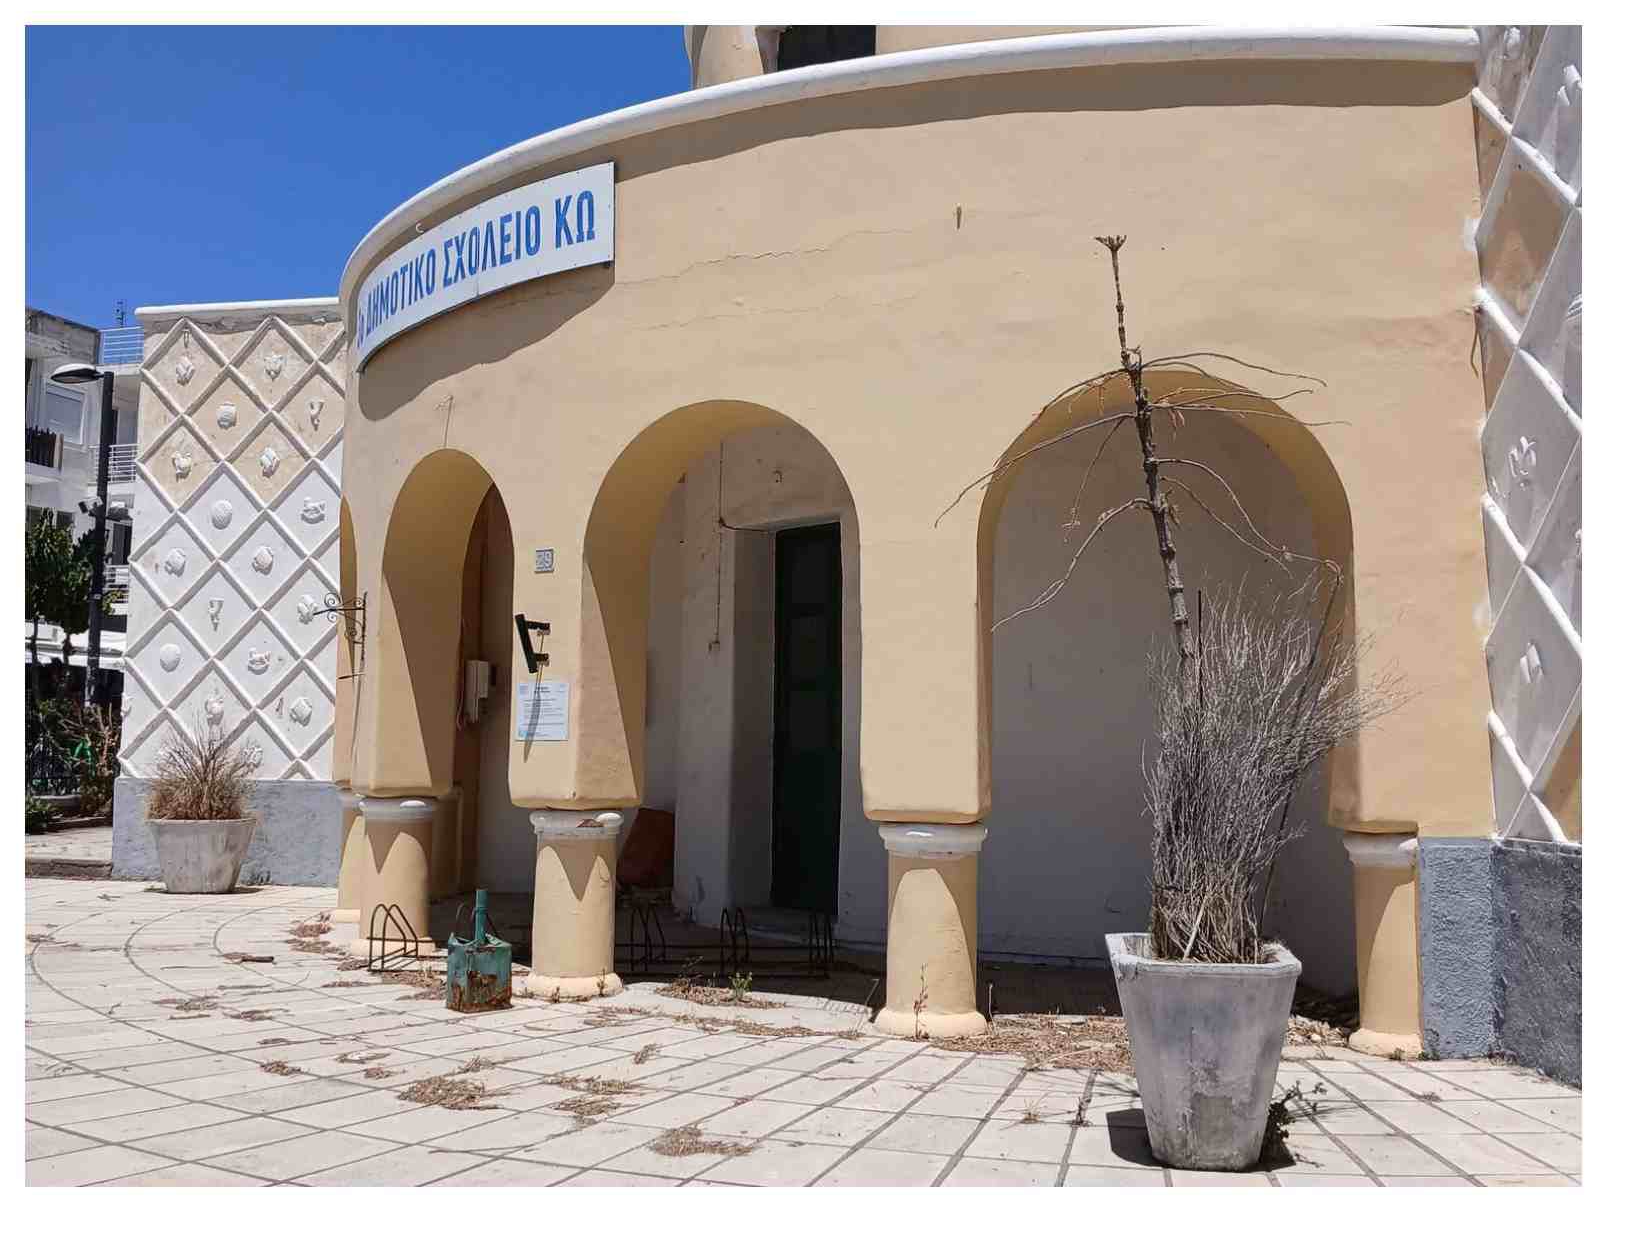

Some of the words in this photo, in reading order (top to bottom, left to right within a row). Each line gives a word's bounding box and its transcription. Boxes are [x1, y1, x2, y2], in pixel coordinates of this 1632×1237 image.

[366, 247, 437, 336] ΔΗΜΟΤΙΚΟ
[442, 205, 542, 288] ΣΧΟΛΕΙΟ
[554, 190, 596, 250] ΚΩ
